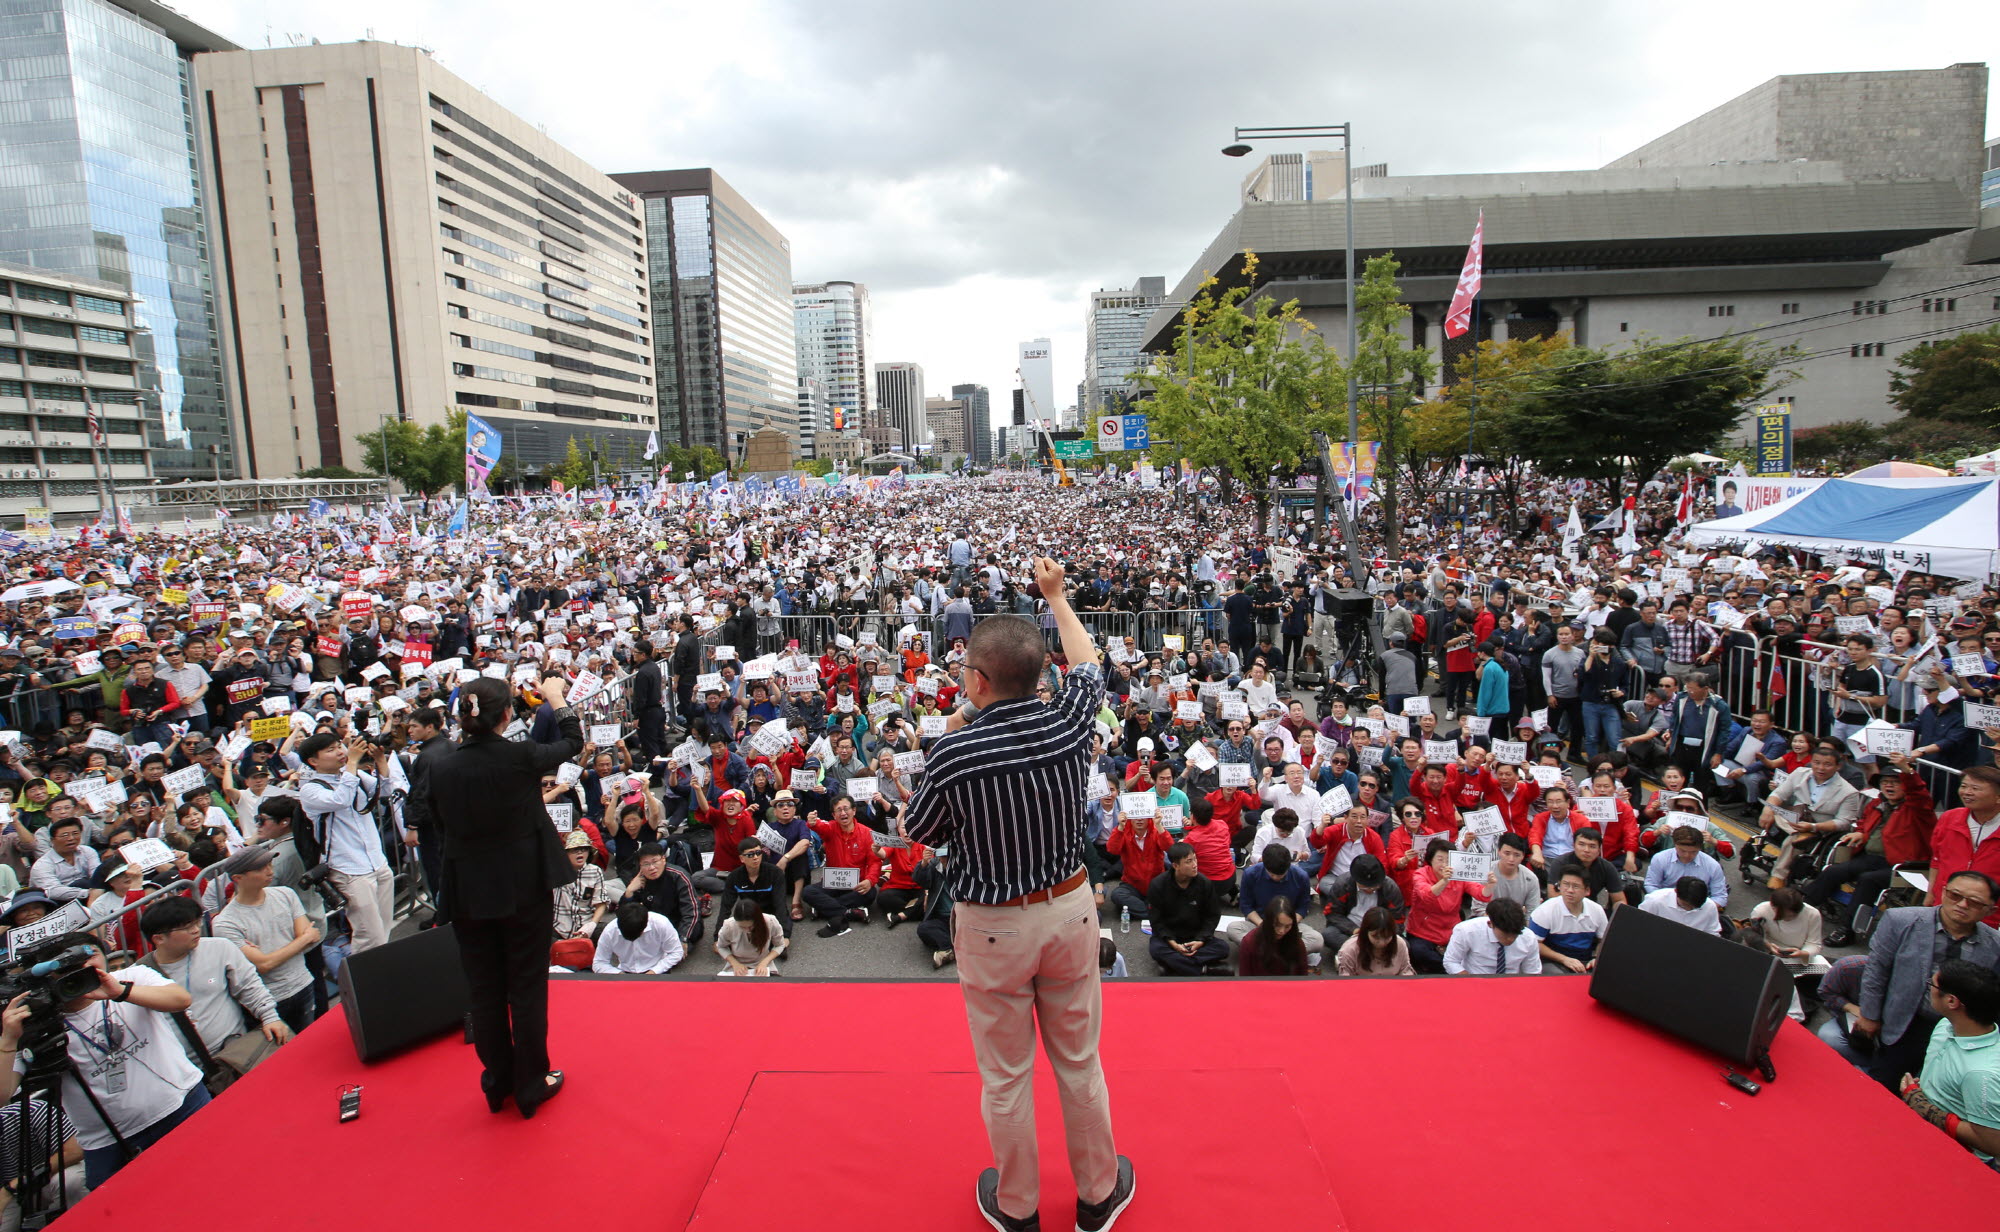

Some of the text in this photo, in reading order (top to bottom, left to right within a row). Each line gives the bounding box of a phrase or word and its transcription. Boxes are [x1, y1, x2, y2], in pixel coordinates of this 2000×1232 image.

[1762, 416, 1784, 460] 편의점
[1745, 486, 1781, 512] 사기탄핵
[196, 604, 224, 612] 문재인
[120, 632, 141, 642] 하야
[328, 641, 342, 650] OUT
[745, 664, 760, 672] 문재인
[788, 674, 816, 686] 문재인 퇴진
[230, 680, 260, 692] 문재인
[235, 688, 258, 700] 하야
[1878, 732, 1904, 740] 지키자!
[556, 809, 569, 818] 심판
[1475, 825, 1498, 834] 대한민국
[14, 920, 65, 945] 文정권 심판
[91, 1054, 129, 1078] BLACK
